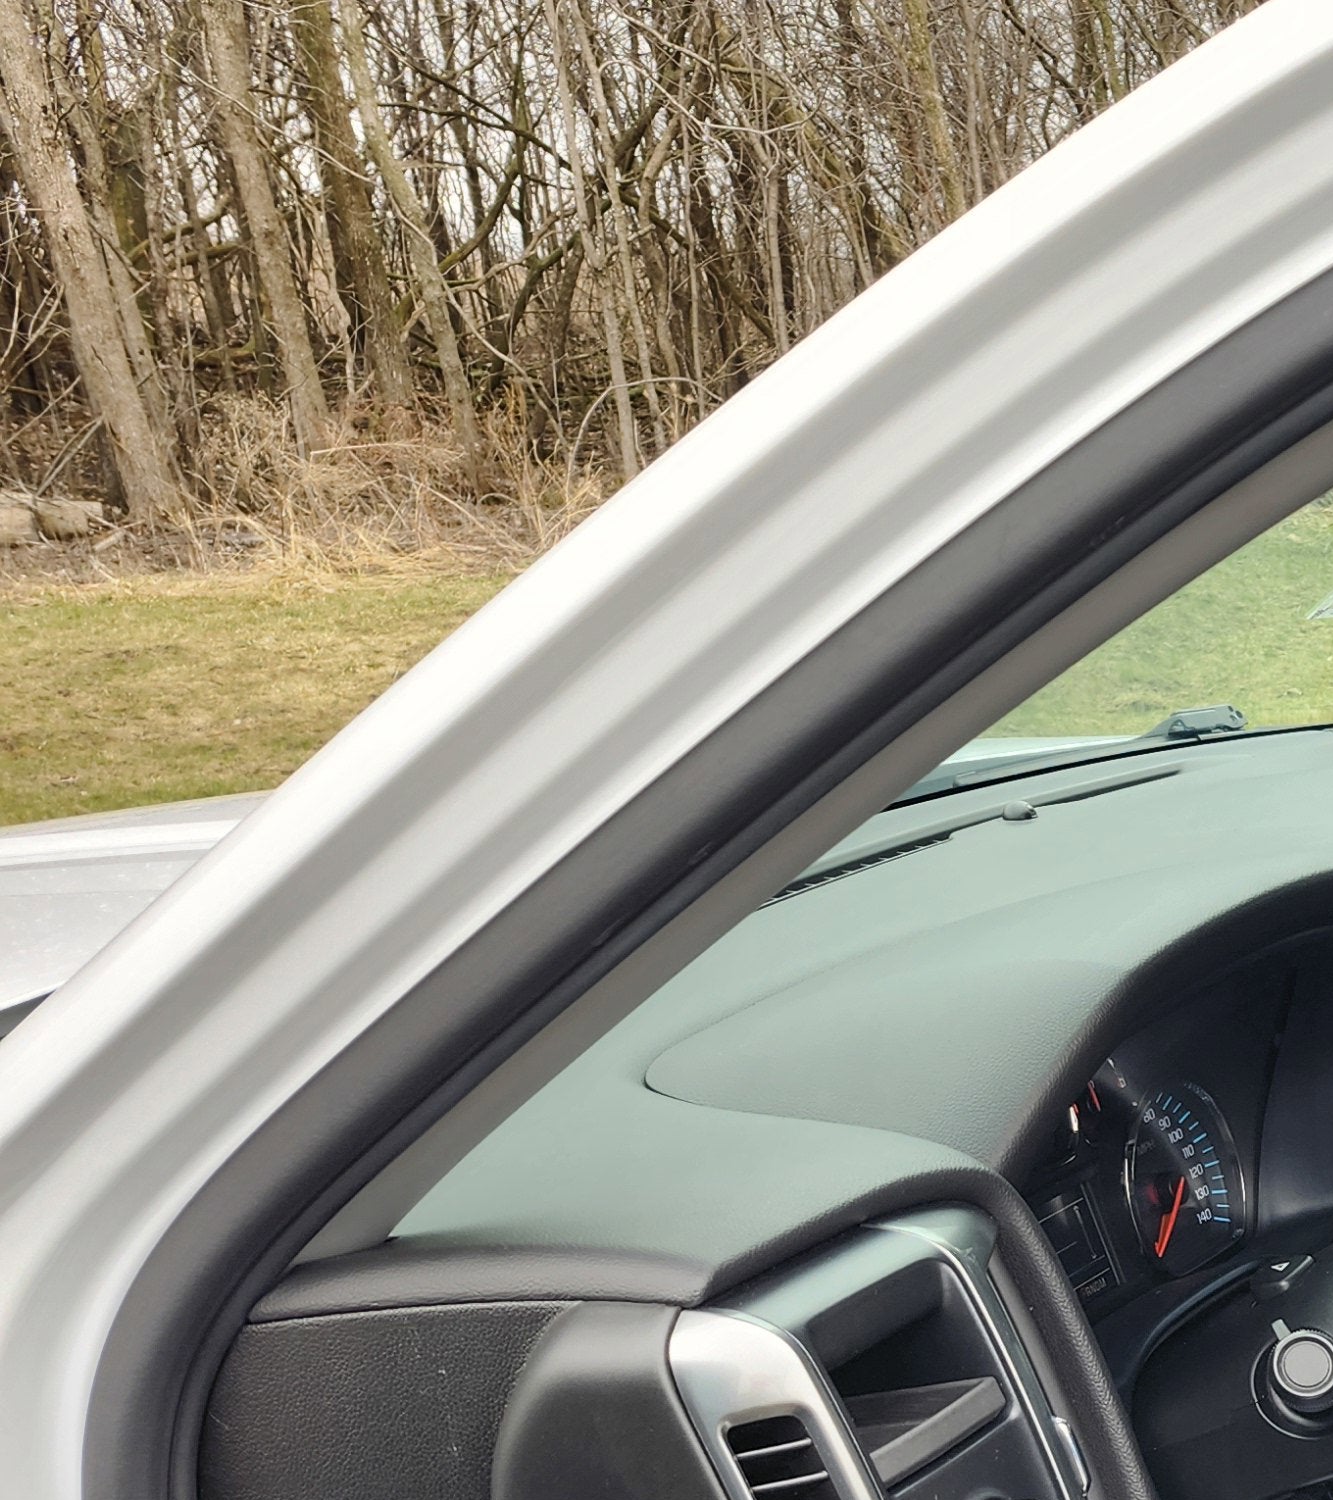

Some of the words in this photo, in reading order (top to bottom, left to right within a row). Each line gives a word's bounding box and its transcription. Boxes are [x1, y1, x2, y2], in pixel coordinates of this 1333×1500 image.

[1158, 1116, 1171, 1131] 90
[1168, 1128, 1184, 1144] 100
[1181, 1144, 1195, 1159] 110
[1189, 1163, 1204, 1179] 120
[1194, 1185, 1210, 1201] 130
[1196, 1208, 1212, 1225] 140
